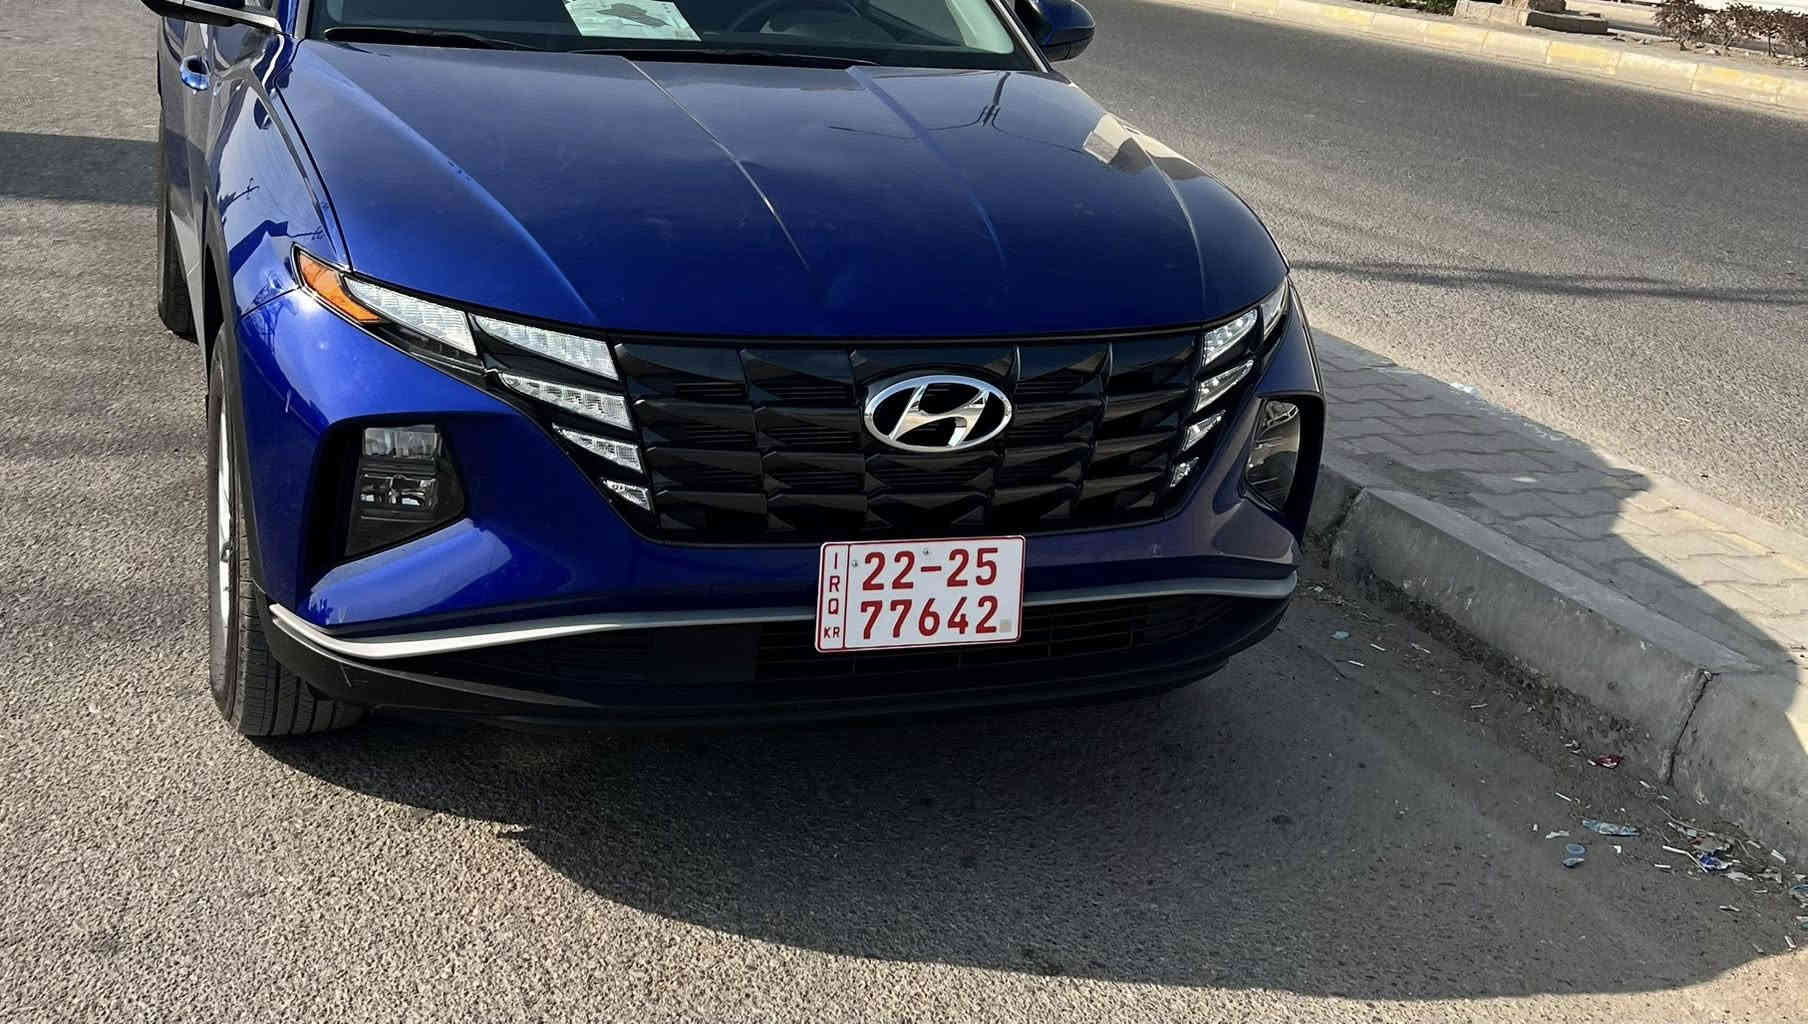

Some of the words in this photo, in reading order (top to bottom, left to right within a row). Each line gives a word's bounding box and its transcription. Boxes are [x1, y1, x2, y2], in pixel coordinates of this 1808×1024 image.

[827, 551, 841, 616] IRQ
[862, 547, 999, 592] 22-25
[823, 626, 841, 639] KR
[860, 594, 1000, 640] 77642
